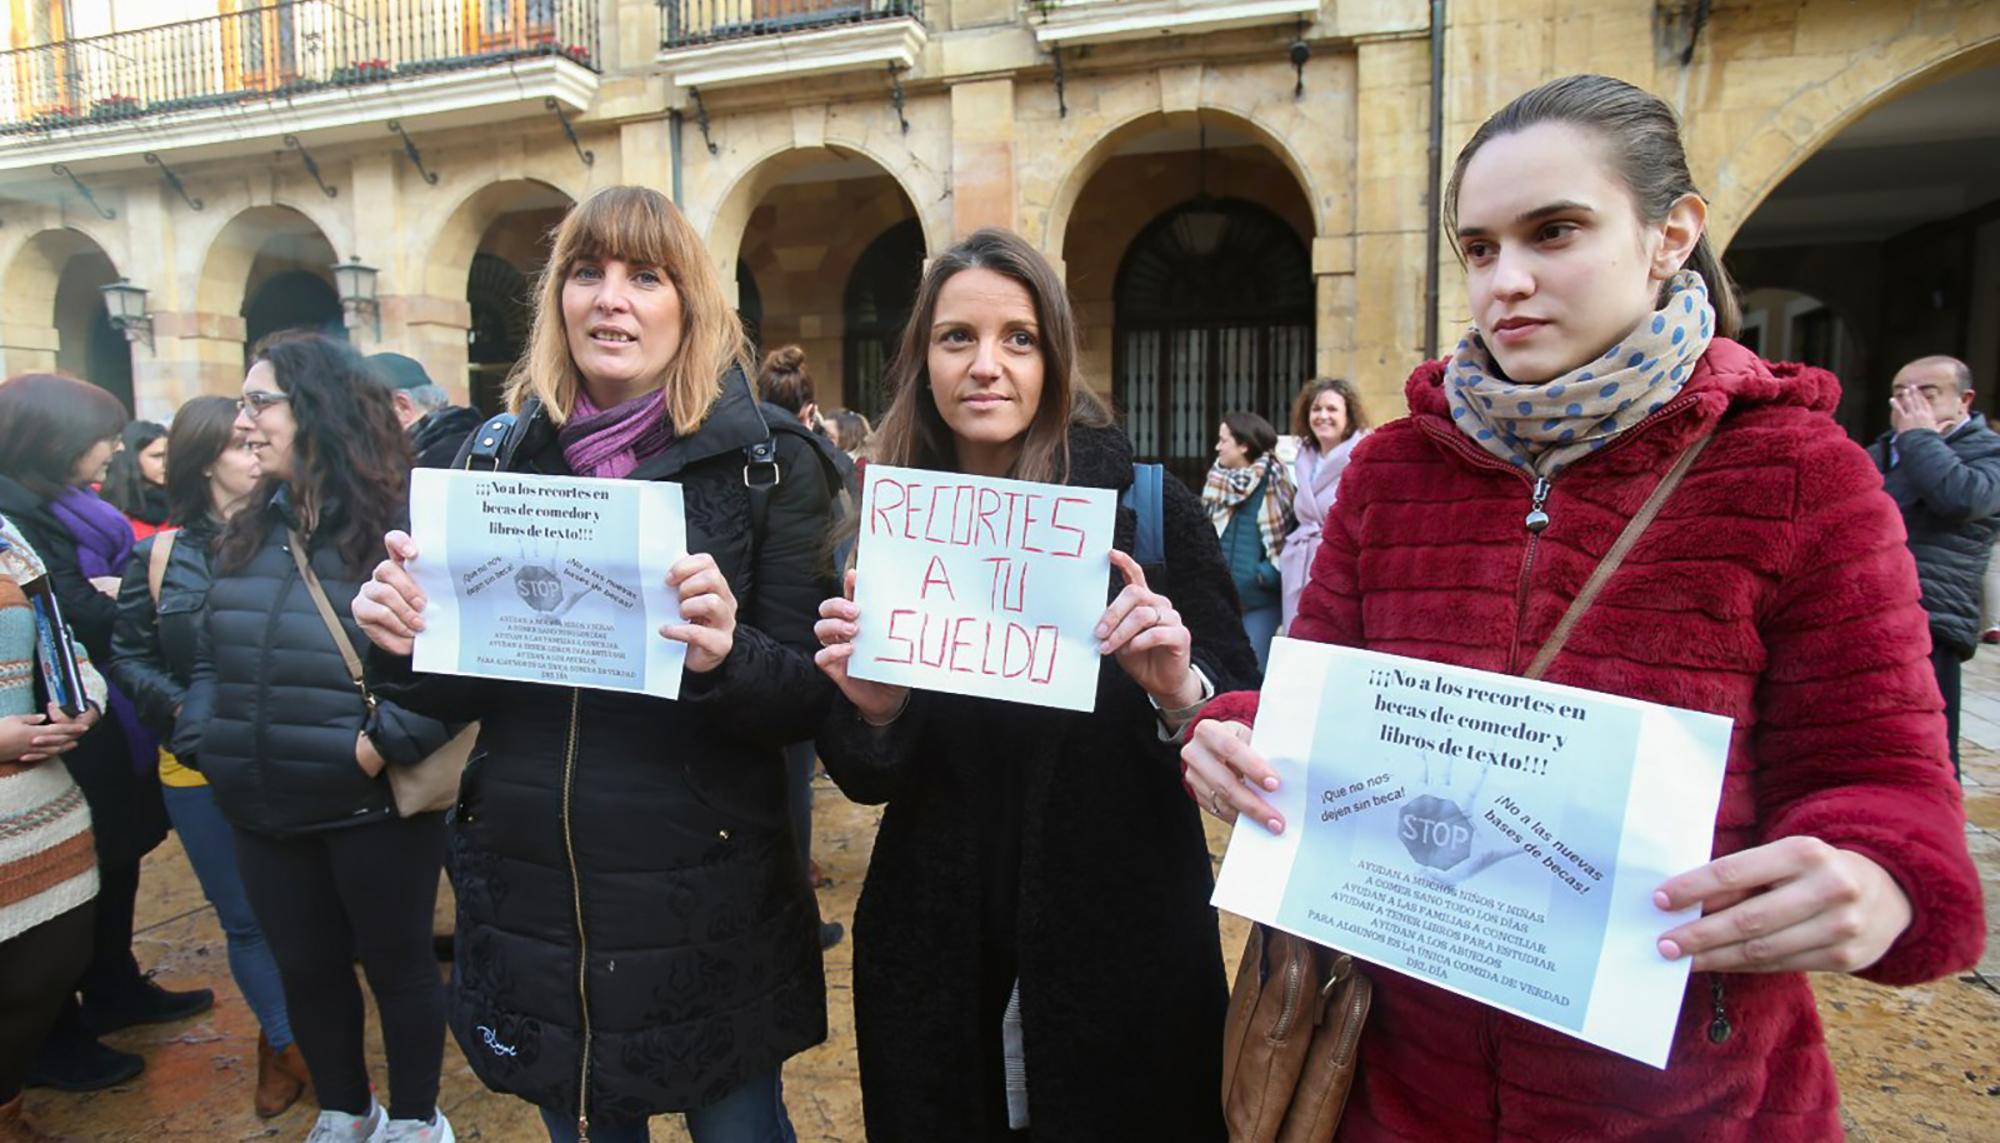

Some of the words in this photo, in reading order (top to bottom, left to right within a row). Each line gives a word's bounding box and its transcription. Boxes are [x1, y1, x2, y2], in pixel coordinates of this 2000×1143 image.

[482, 500, 517, 514] becas
[518, 503, 534, 516] de
[535, 506, 592, 520] comedor
[592, 511, 601, 524] y
[508, 485, 516, 496] a
[518, 482, 537, 496] los
[538, 486, 592, 500] recortes
[593, 490, 609, 500] en
[489, 521, 525, 536] libros
[526, 524, 543, 537] de
[544, 527, 593, 541] texto!!!
[870, 479, 1092, 558] RECORTES
[517, 579, 560, 600] STOP
[920, 555, 955, 601] A
[981, 556, 1028, 612] TU
[874, 609, 1059, 685] SUELDO
[1369, 669, 1416, 688] ¡¡¡No
[1419, 680, 1431, 691] a
[1435, 676, 1464, 697] los
[1466, 686, 1555, 715] recortes
[1559, 704, 1587, 721] en
[1374, 694, 1427, 719] becas
[1430, 706, 1454, 725] de
[1457, 715, 1551, 745] comedor
[1552, 734, 1568, 752] y
[1380, 724, 1435, 751] libros
[1438, 737, 1463, 757] de
[1466, 744, 1549, 776] texto!!!
[1320, 787, 1347, 804] ¡Que
[1348, 781, 1365, 794] no
[1367, 772, 1391, 788] nos
[1320, 806, 1351, 823] dejen
[1353, 798, 1372, 813] sin
[1373, 786, 1406, 806] beca!
[1402, 814, 1470, 850] STOP
[1484, 809, 1524, 844] bases
[1523, 842, 1542, 858] de
[1541, 856, 1591, 895] becas!
[1494, 795, 1521, 816] ¡No
[1520, 815, 1531, 825] a
[1530, 821, 1553, 842] las
[1552, 840, 1604, 881] nuevas
[1358, 860, 1401, 880] AYUDAN
[1402, 874, 1410, 883] A
[1412, 876, 1457, 897] MUCHOS
[1497, 901, 1506, 912] Y
[1365, 876, 1373, 886] A
[1375, 879, 1412, 897] COMER
[1413, 890, 1443, 906] SANO
[1445, 901, 1475, 917] TODO
[1478, 909, 1498, 924] LOS
[1500, 915, 1529, 934] DÍAS
[1330, 892, 1375, 912] AYUDAN
[1375, 906, 1384, 916] A
[1385, 908, 1421, 927] TENER
[1422, 920, 1461, 941] LIBROS
[1462, 933, 1494, 952] PARA
[1496, 945, 1557, 972] ESTUDIAR
[1342, 883, 1387, 902] AYUDAN
[1388, 896, 1395, 906] A
[1396, 898, 1418, 911] LAS
[1419, 905, 1472, 930] FAMILIAS
[1472, 923, 1480, 934] A
[1482, 926, 1547, 955] CONCILIAR
[1371, 918, 1416, 939] AYUDAN
[1417, 934, 1425, 944] A
[1426, 935, 1448, 951] LOS
[1448, 943, 1503, 969] ABUELOS
[1307, 909, 1334, 927] PARA
[1335, 920, 1386, 943] ALGUNOS
[1386, 937, 1401, 949] ES
[1401, 942, 1416, 955] LA
[1453, 959, 1499, 983] COMIDA
[1500, 975, 1518, 989] DE
[1519, 983, 1571, 1007] VERDAD
[1406, 957, 1428, 972] DEL
[1428, 964, 1449, 979] DÍA
